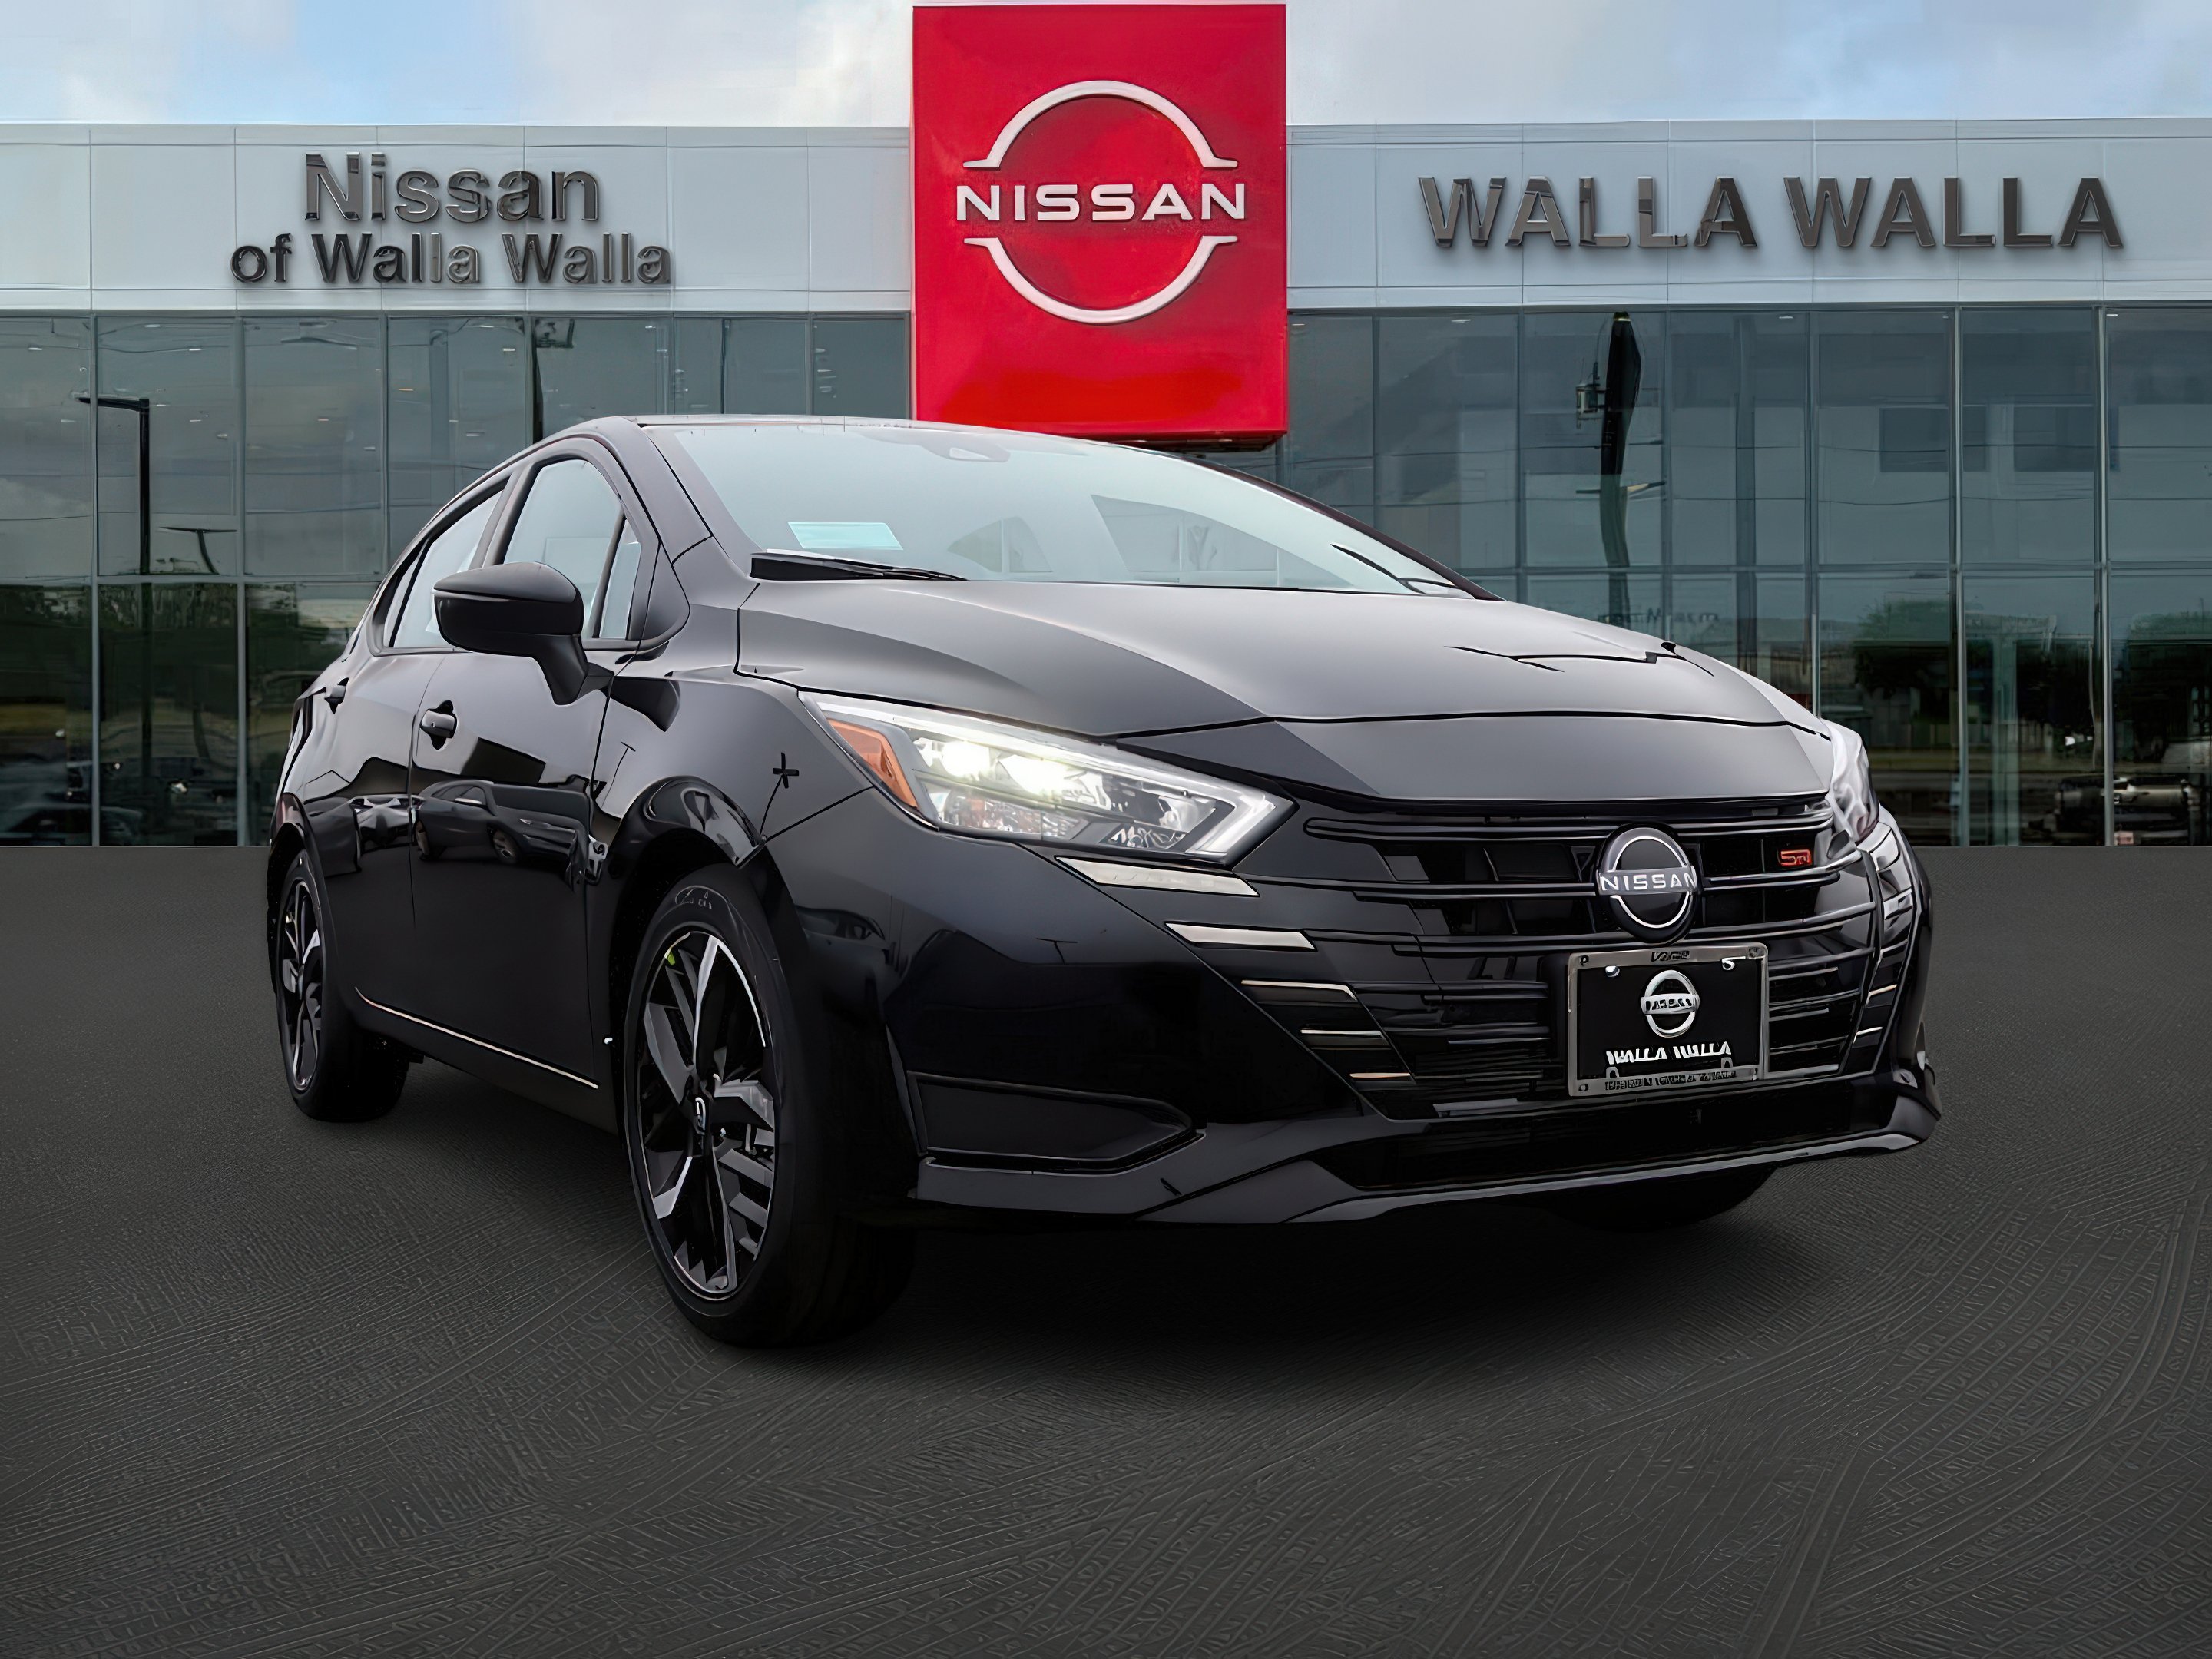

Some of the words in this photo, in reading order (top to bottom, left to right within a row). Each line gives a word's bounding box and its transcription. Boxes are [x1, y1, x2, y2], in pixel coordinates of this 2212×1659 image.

[305, 151, 599, 222] Nissan
[956, 183, 1245, 221] NISSAN
[1417, 176, 1758, 247] WALLA
[1783, 176, 2124, 247] WALLA
[230, 233, 293, 283] of
[310, 233, 481, 284] Walla
[502, 232, 671, 284] Walla
[1600, 872, 1697, 892] NISSAN
